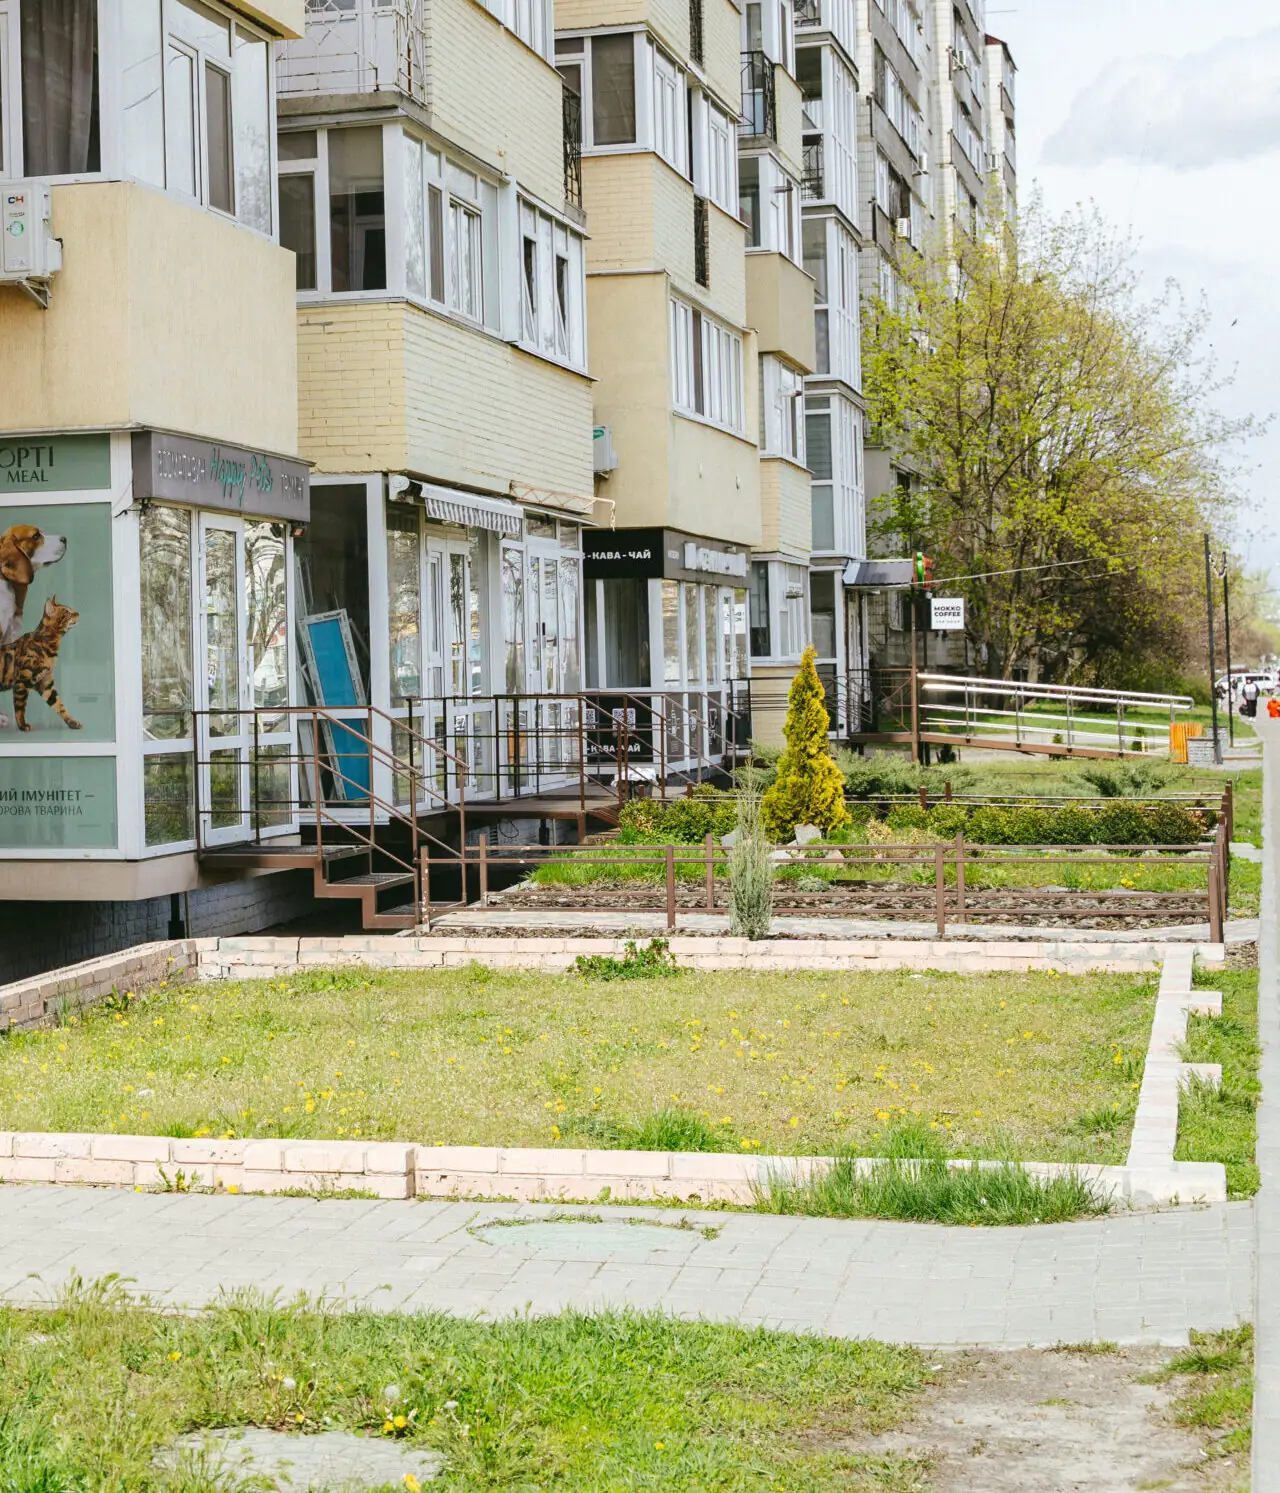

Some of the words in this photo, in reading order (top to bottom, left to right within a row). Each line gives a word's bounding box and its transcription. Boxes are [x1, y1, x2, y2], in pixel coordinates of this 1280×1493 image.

[7, 469, 49, 482] MEAL
[22, 789, 82, 802] ІМУНІТЕТ
[34, 805, 83, 816] ТВАРИНА
